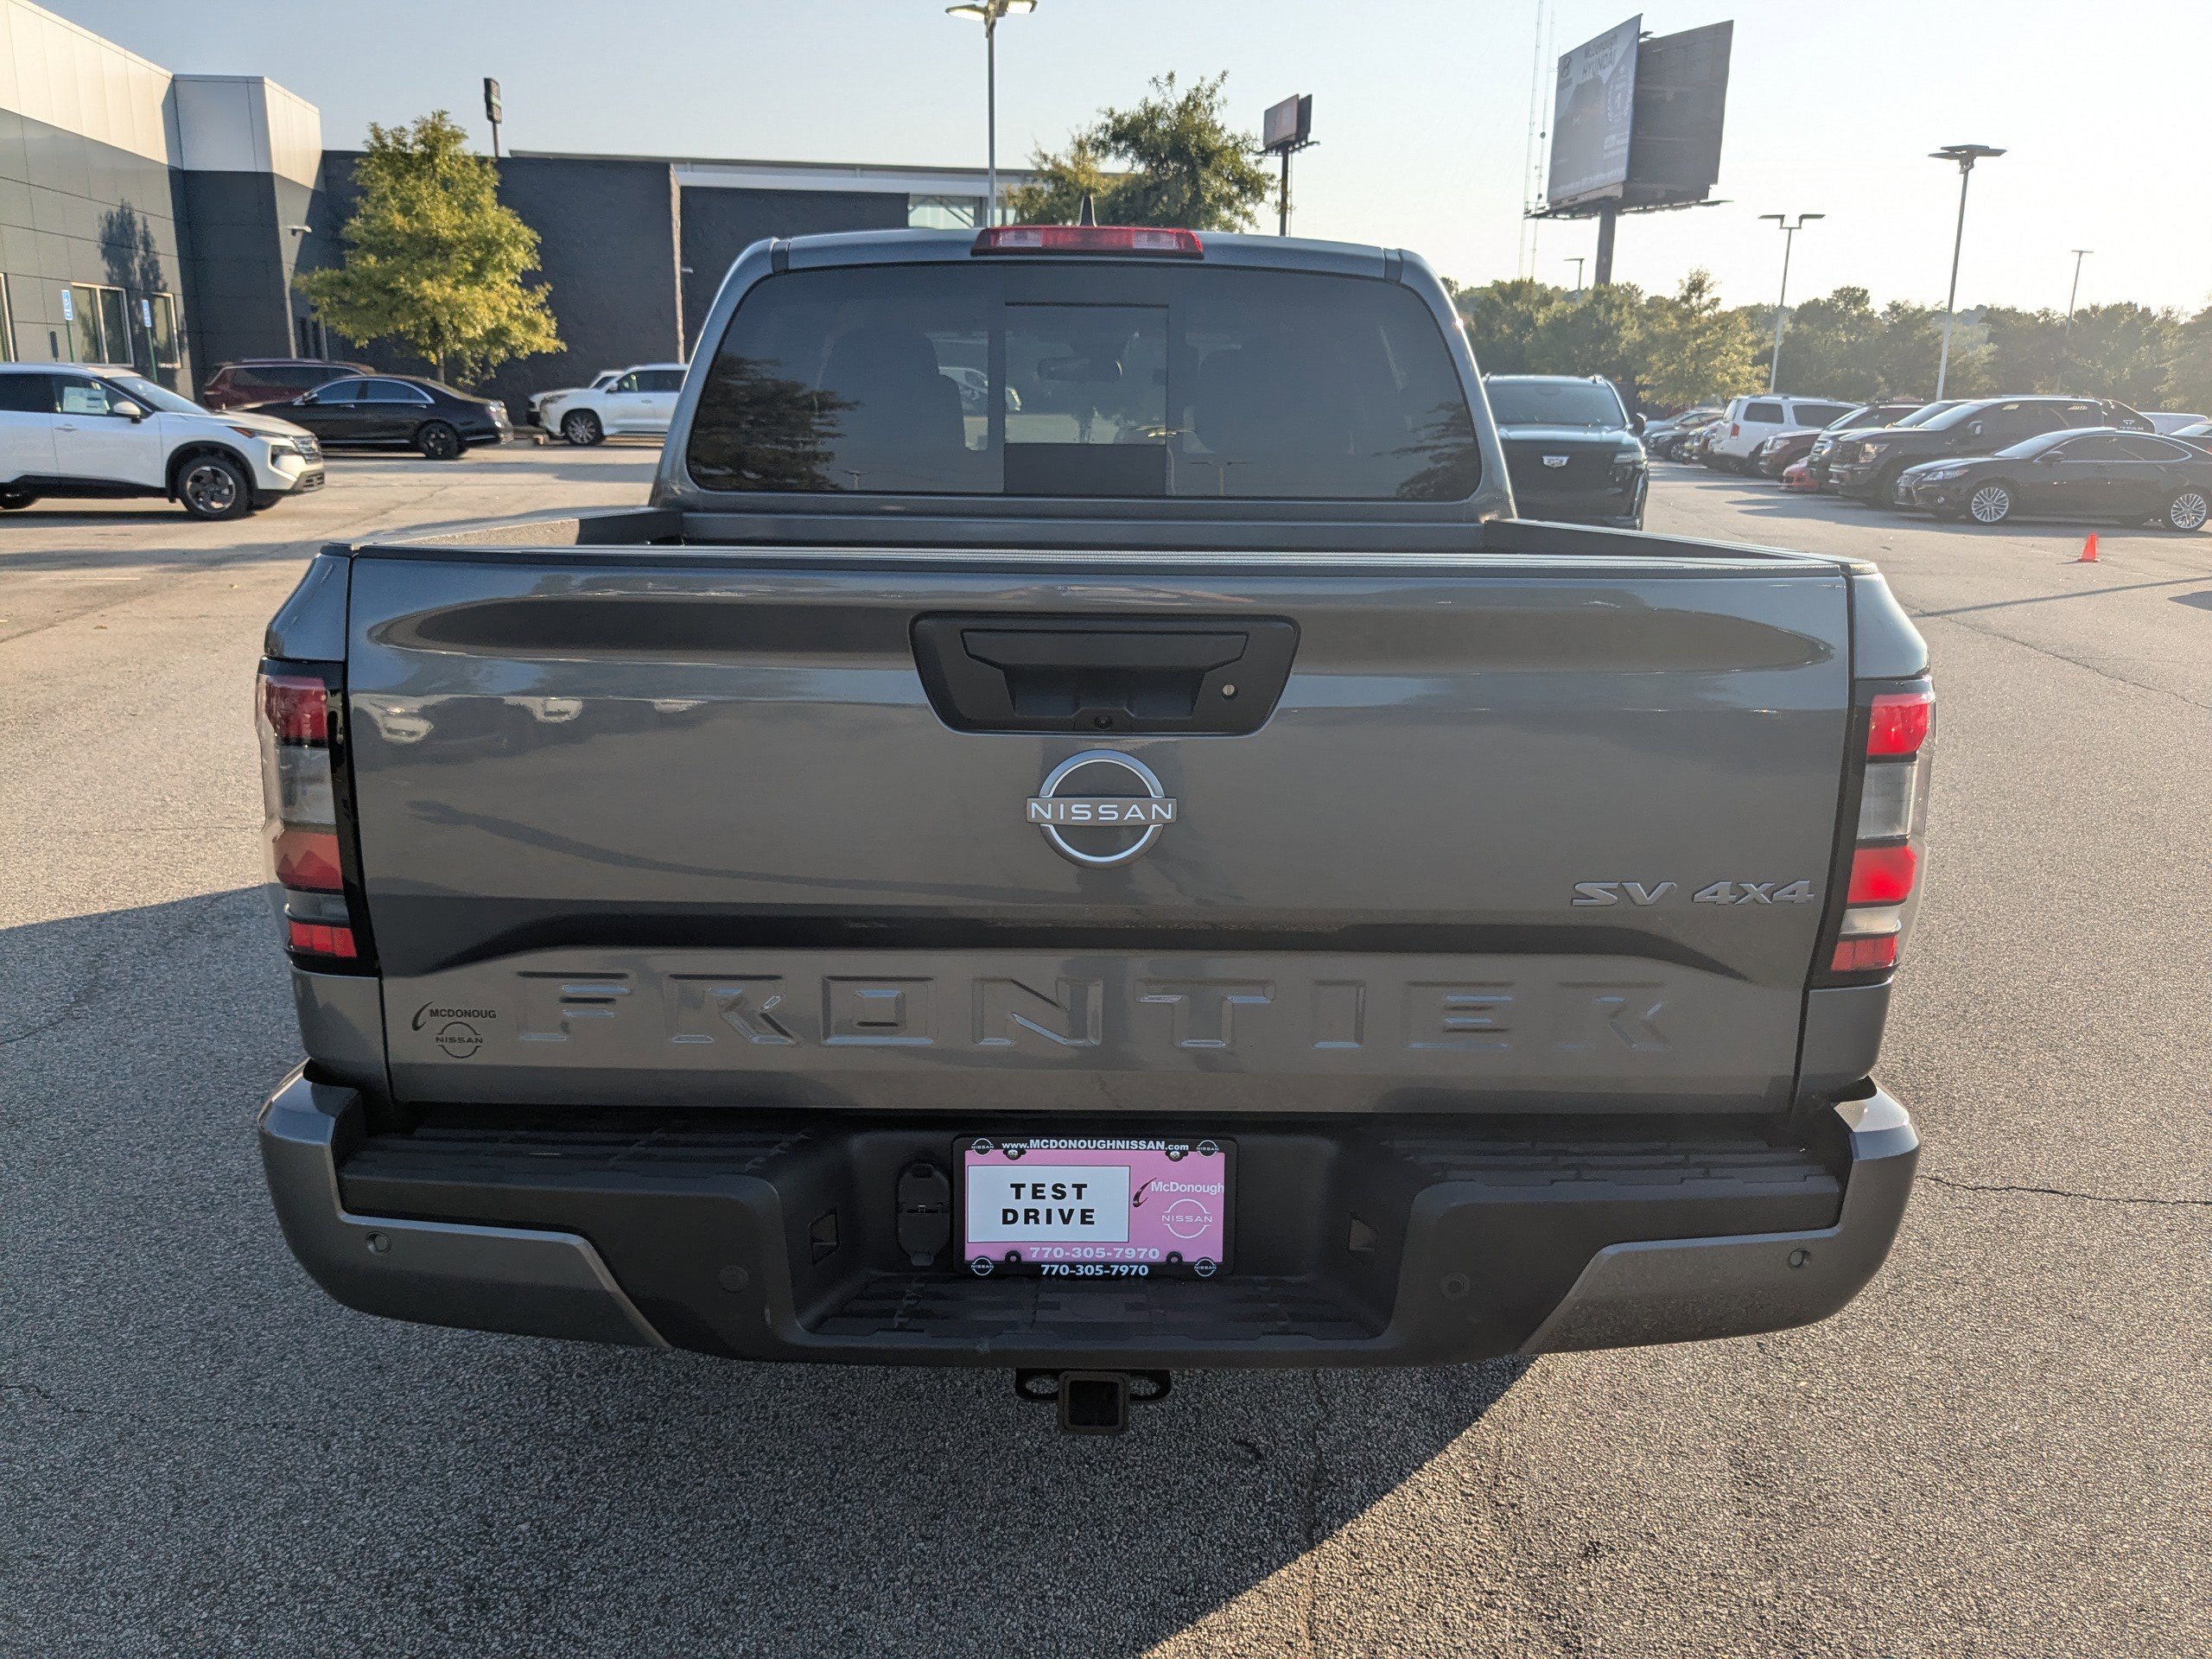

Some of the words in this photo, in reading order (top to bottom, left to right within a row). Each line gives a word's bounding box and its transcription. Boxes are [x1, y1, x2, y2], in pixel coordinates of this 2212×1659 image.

[1031, 802, 1172, 821] NISSAN
[1571, 881, 1675, 906] SV
[1693, 880, 1815, 905] 4x4
[429, 1008, 497, 1019] MCDONOUG
[517, 971, 1671, 1052] FRONTIER
[1001, 1139, 1189, 1151] www.MCDONOUGHNISSAN.com
[1009, 1183, 1088, 1200] TEST
[1151, 1181, 1224, 1195] McDonough
[1001, 1208, 1095, 1225] DRIVE
[1030, 1247, 1160, 1260] 770-305-7970
[1040, 1264, 1149, 1276] 770-305-7970
